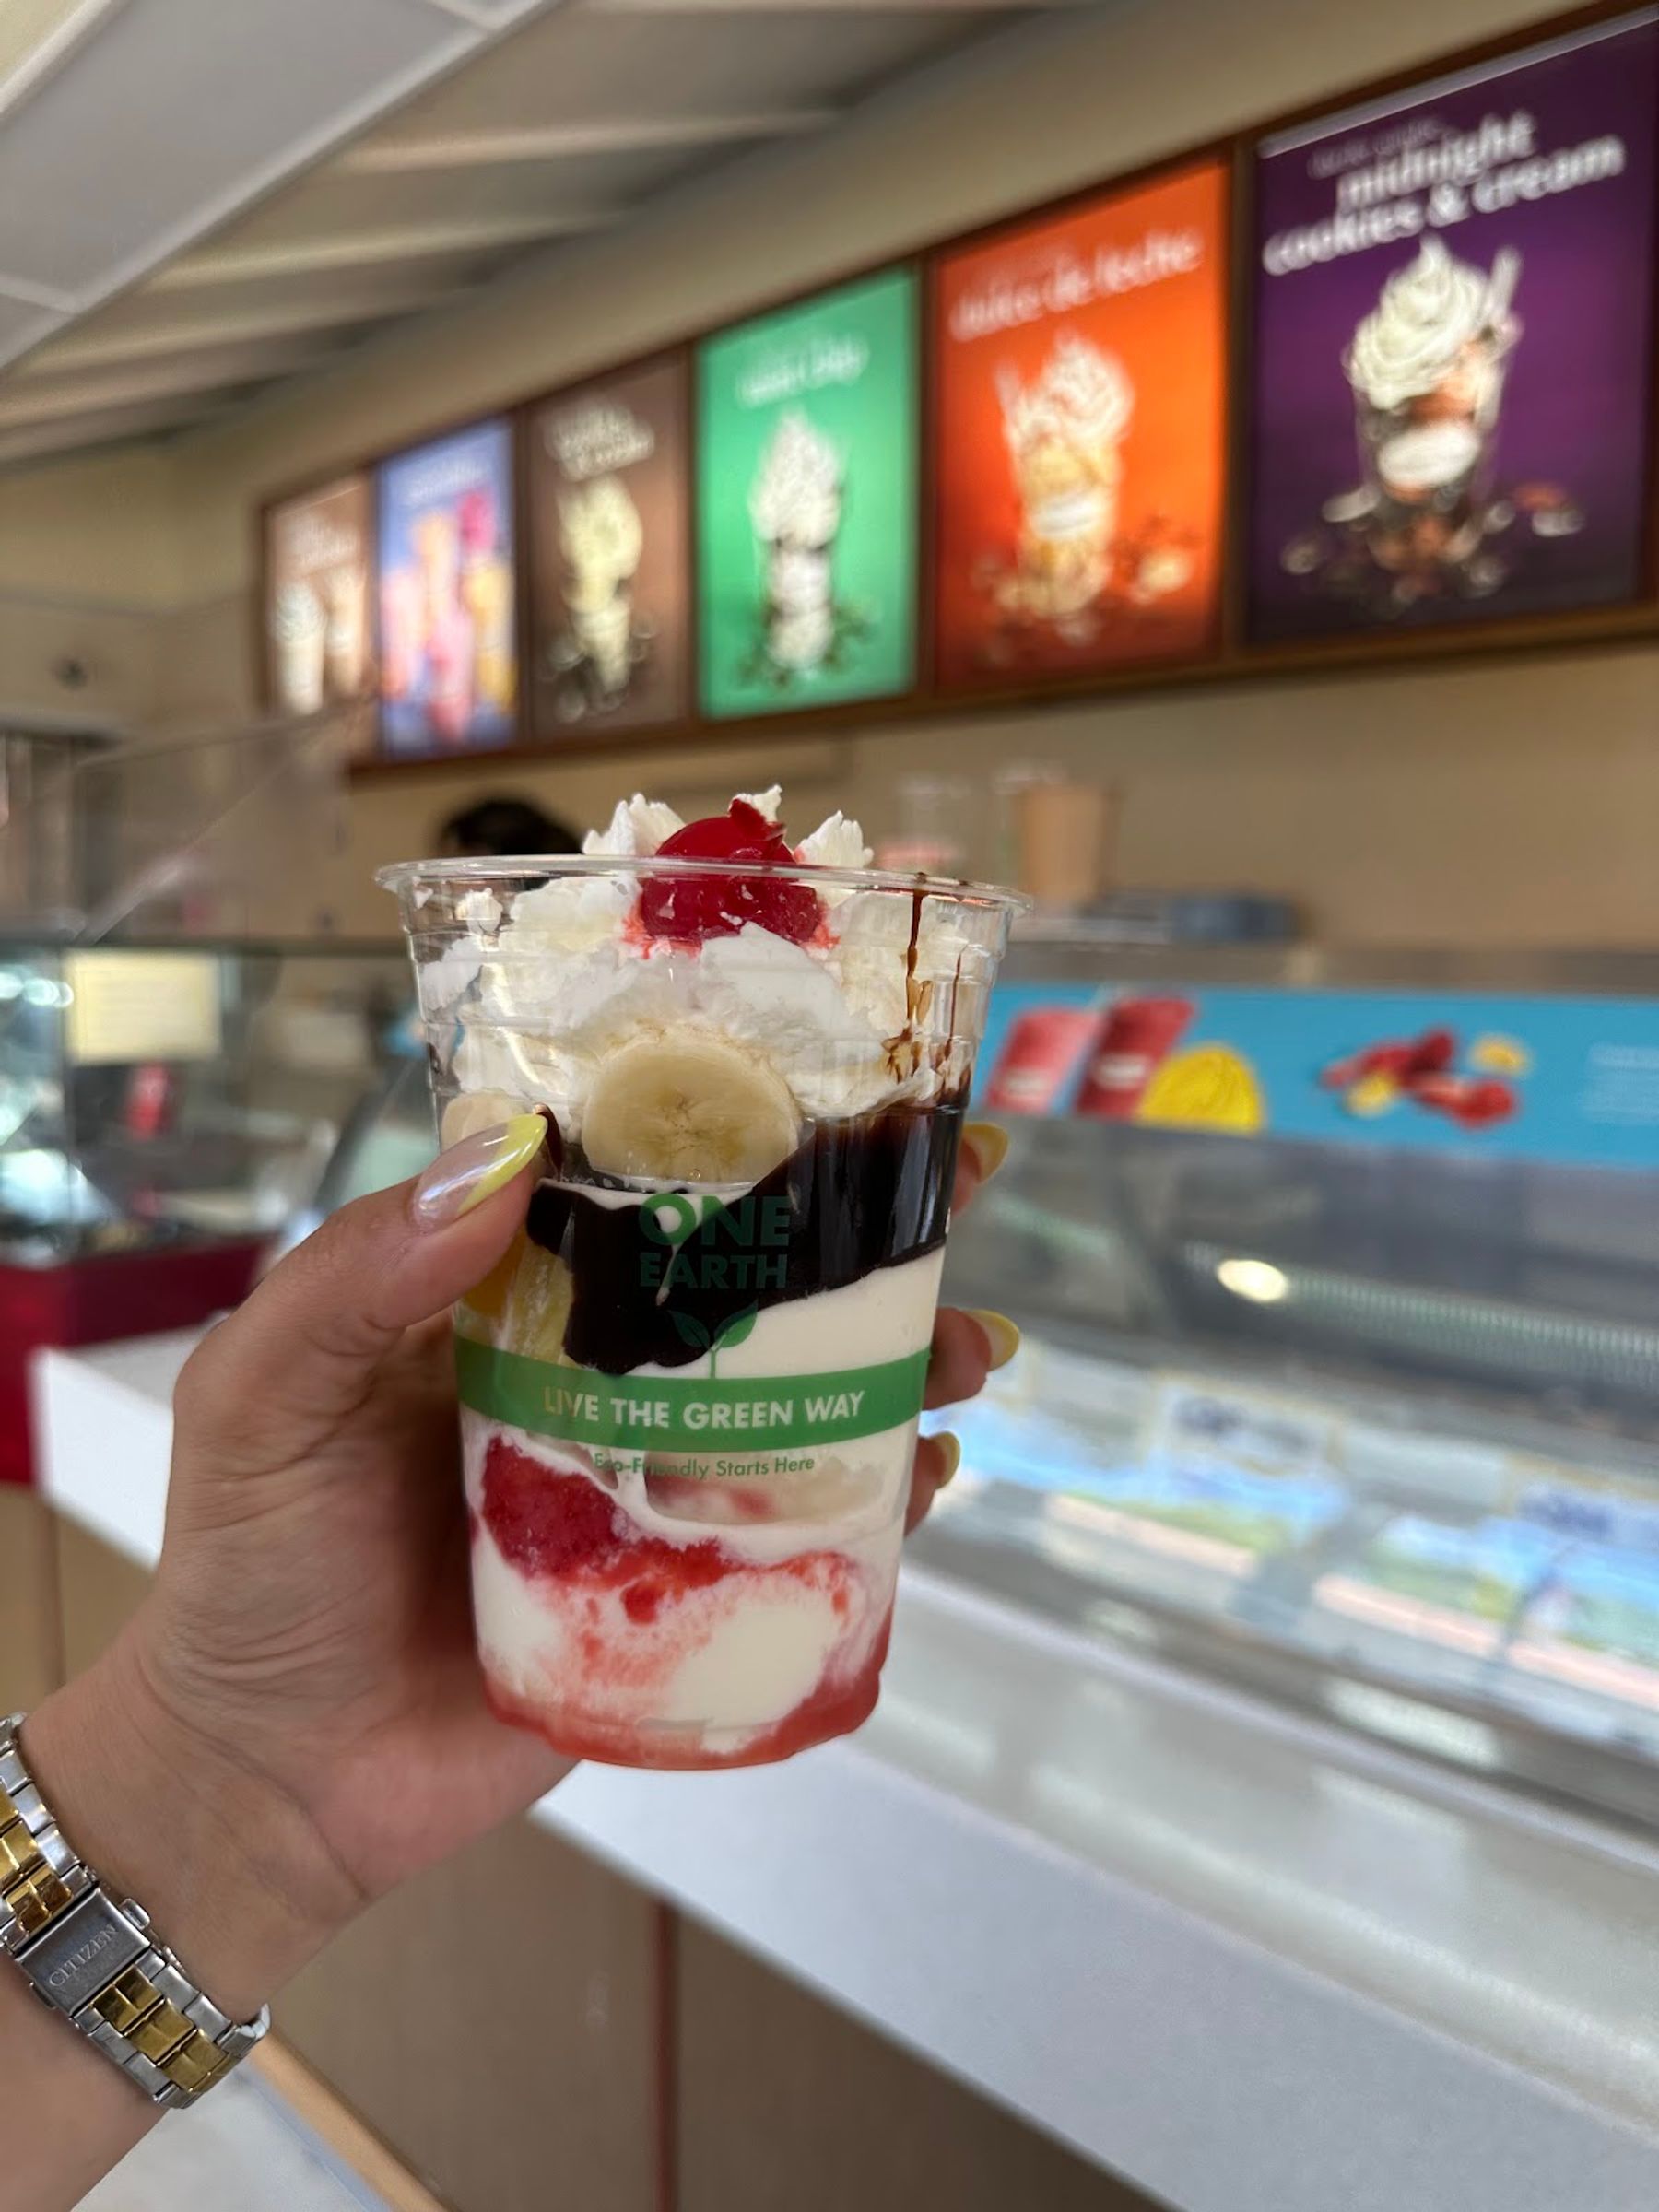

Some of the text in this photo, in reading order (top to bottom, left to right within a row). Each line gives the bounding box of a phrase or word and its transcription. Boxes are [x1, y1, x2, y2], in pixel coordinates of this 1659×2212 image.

[1337, 109, 1535, 213] midnight
[1263, 195, 1424, 275] cookies
[1426, 184, 1471, 228] &
[1473, 135, 1627, 213] cream
[639, 1193, 791, 1246] ONE
[640, 1252, 788, 1289] EARTH
[544, 1386, 865, 1430] LIVE THE GREEN WAY
[716, 1460, 769, 1477] Starts
[774, 1457, 815, 1473] Here
[49, 1924, 118, 1986] CITIZEN
